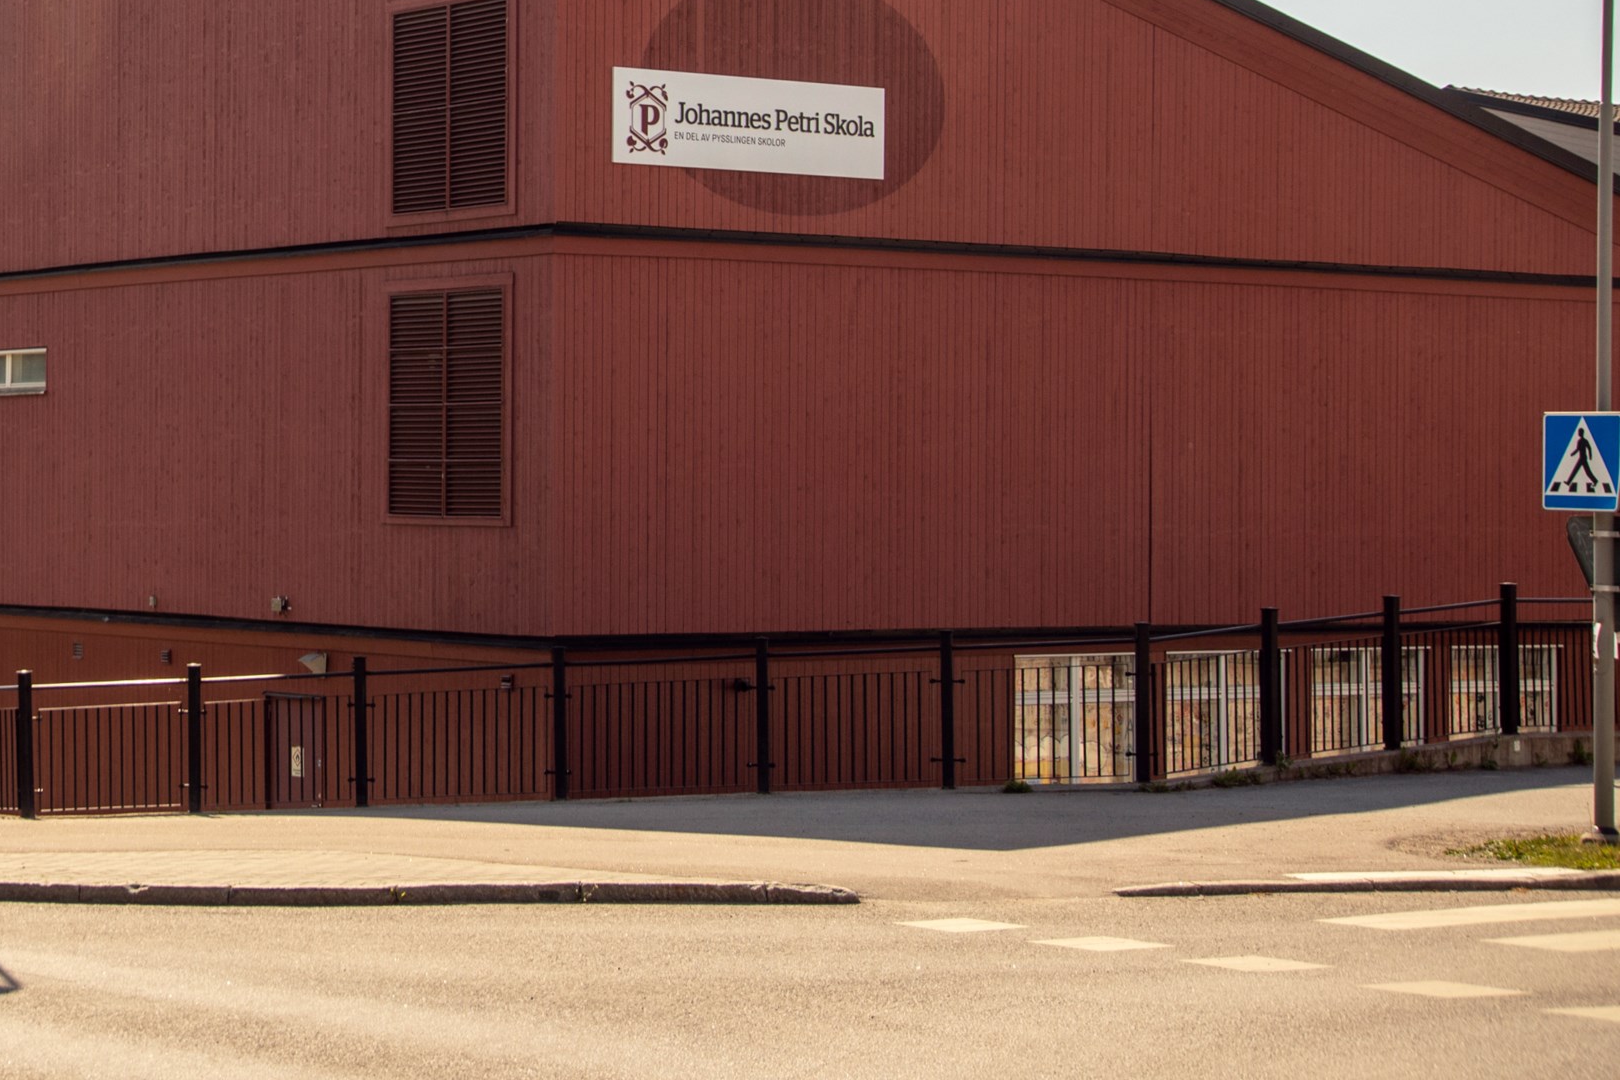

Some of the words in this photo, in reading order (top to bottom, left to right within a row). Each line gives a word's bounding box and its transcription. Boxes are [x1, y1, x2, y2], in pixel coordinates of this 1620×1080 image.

[639, 104, 660, 136] P
[674, 102, 771, 130] Johannes
[775, 109, 820, 134] Petri
[823, 113, 875, 138] Skola
[674, 131, 685, 141] EN
[686, 132, 700, 141] DEL
[700, 133, 711, 142] AV
[712, 134, 756, 145] PYSSLINGEN
[757, 136, 786, 148] SKOLOR
